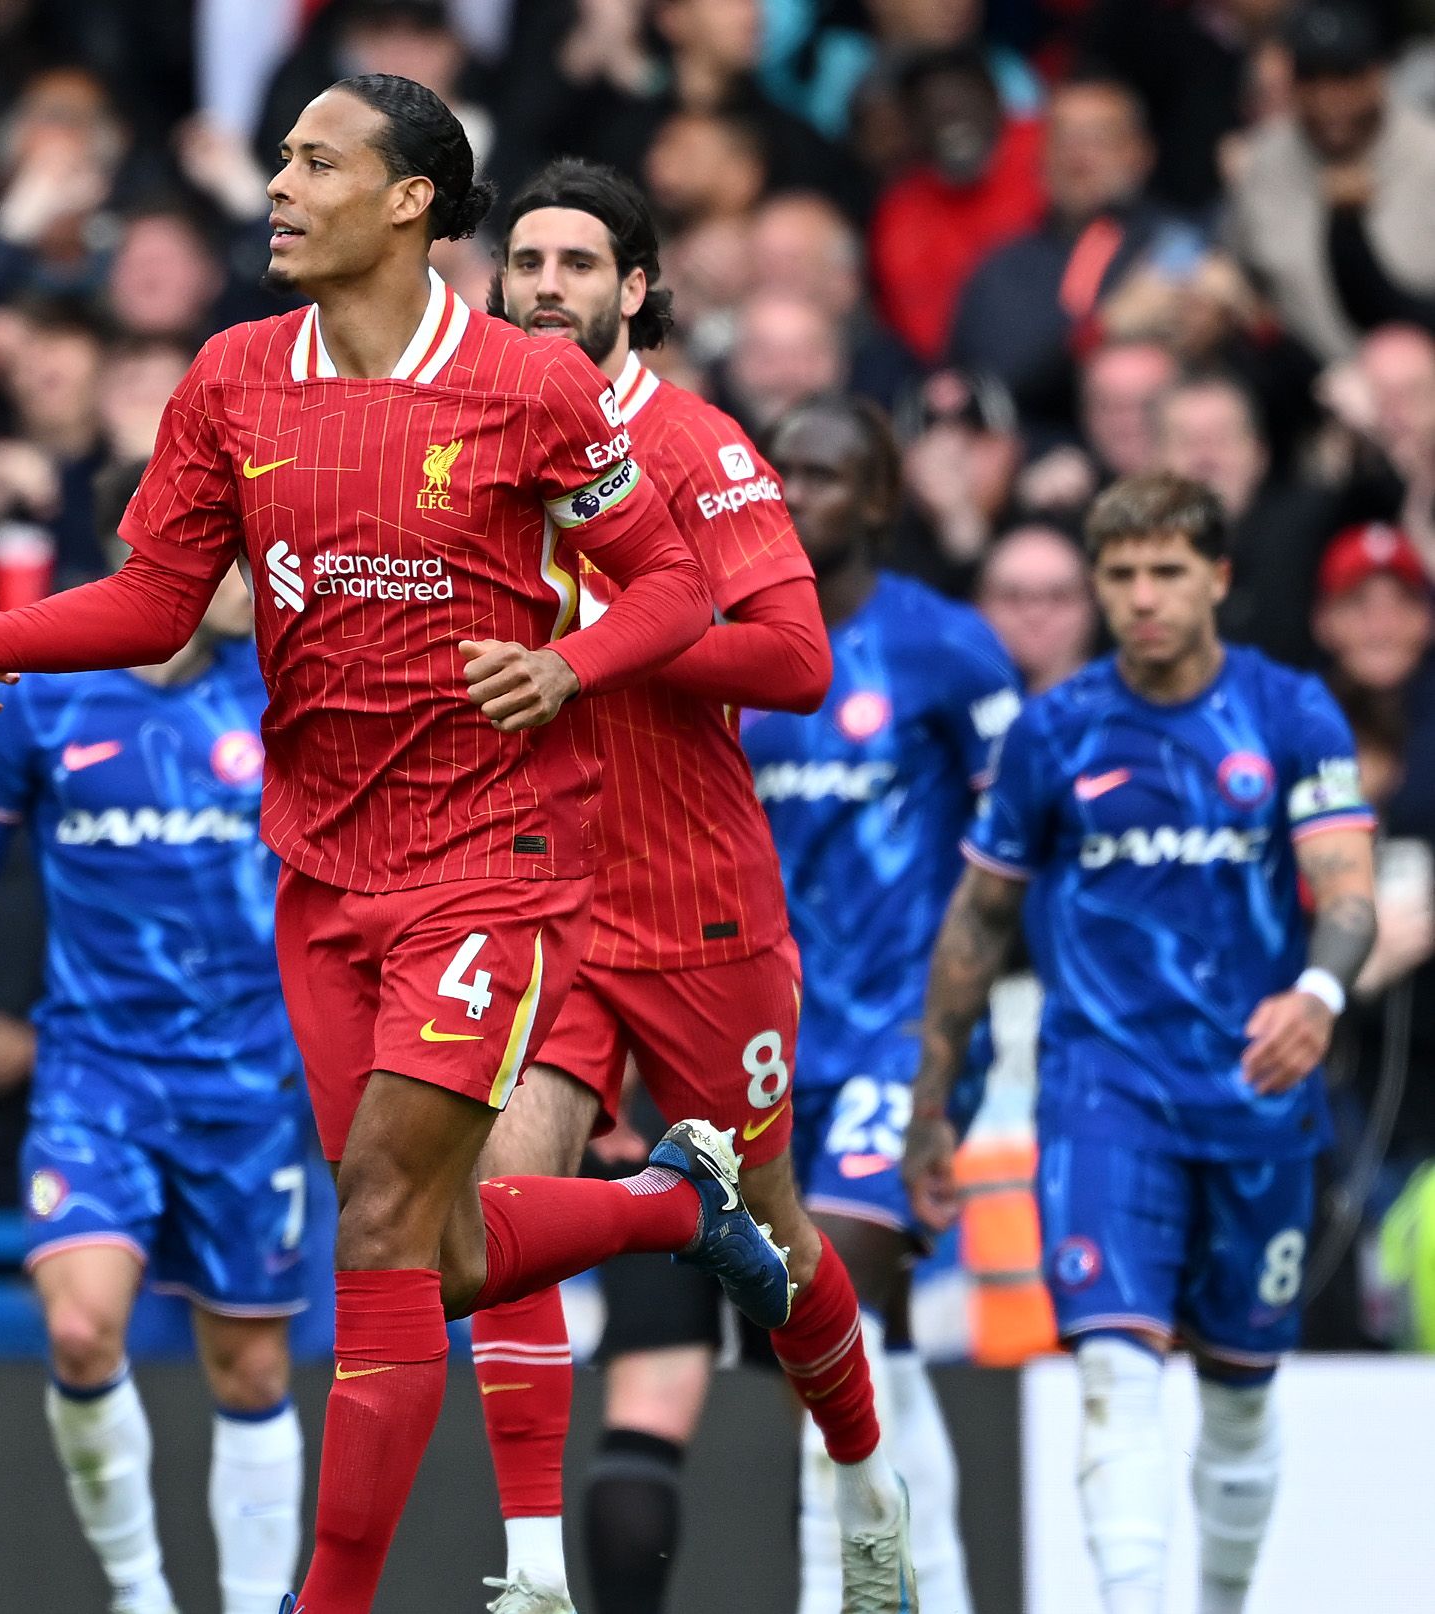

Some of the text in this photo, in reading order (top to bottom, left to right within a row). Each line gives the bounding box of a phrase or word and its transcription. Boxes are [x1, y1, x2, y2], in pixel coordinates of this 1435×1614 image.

[696, 475, 782, 520] Expedia
[313, 550, 443, 578] standard
[313, 575, 454, 601] chartered
[437, 932, 493, 1021] 4
[742, 1029, 788, 1110] 8
[825, 1074, 914, 1163] 23
[270, 1165, 304, 1250] 7
[1258, 1228, 1306, 1307] 8
